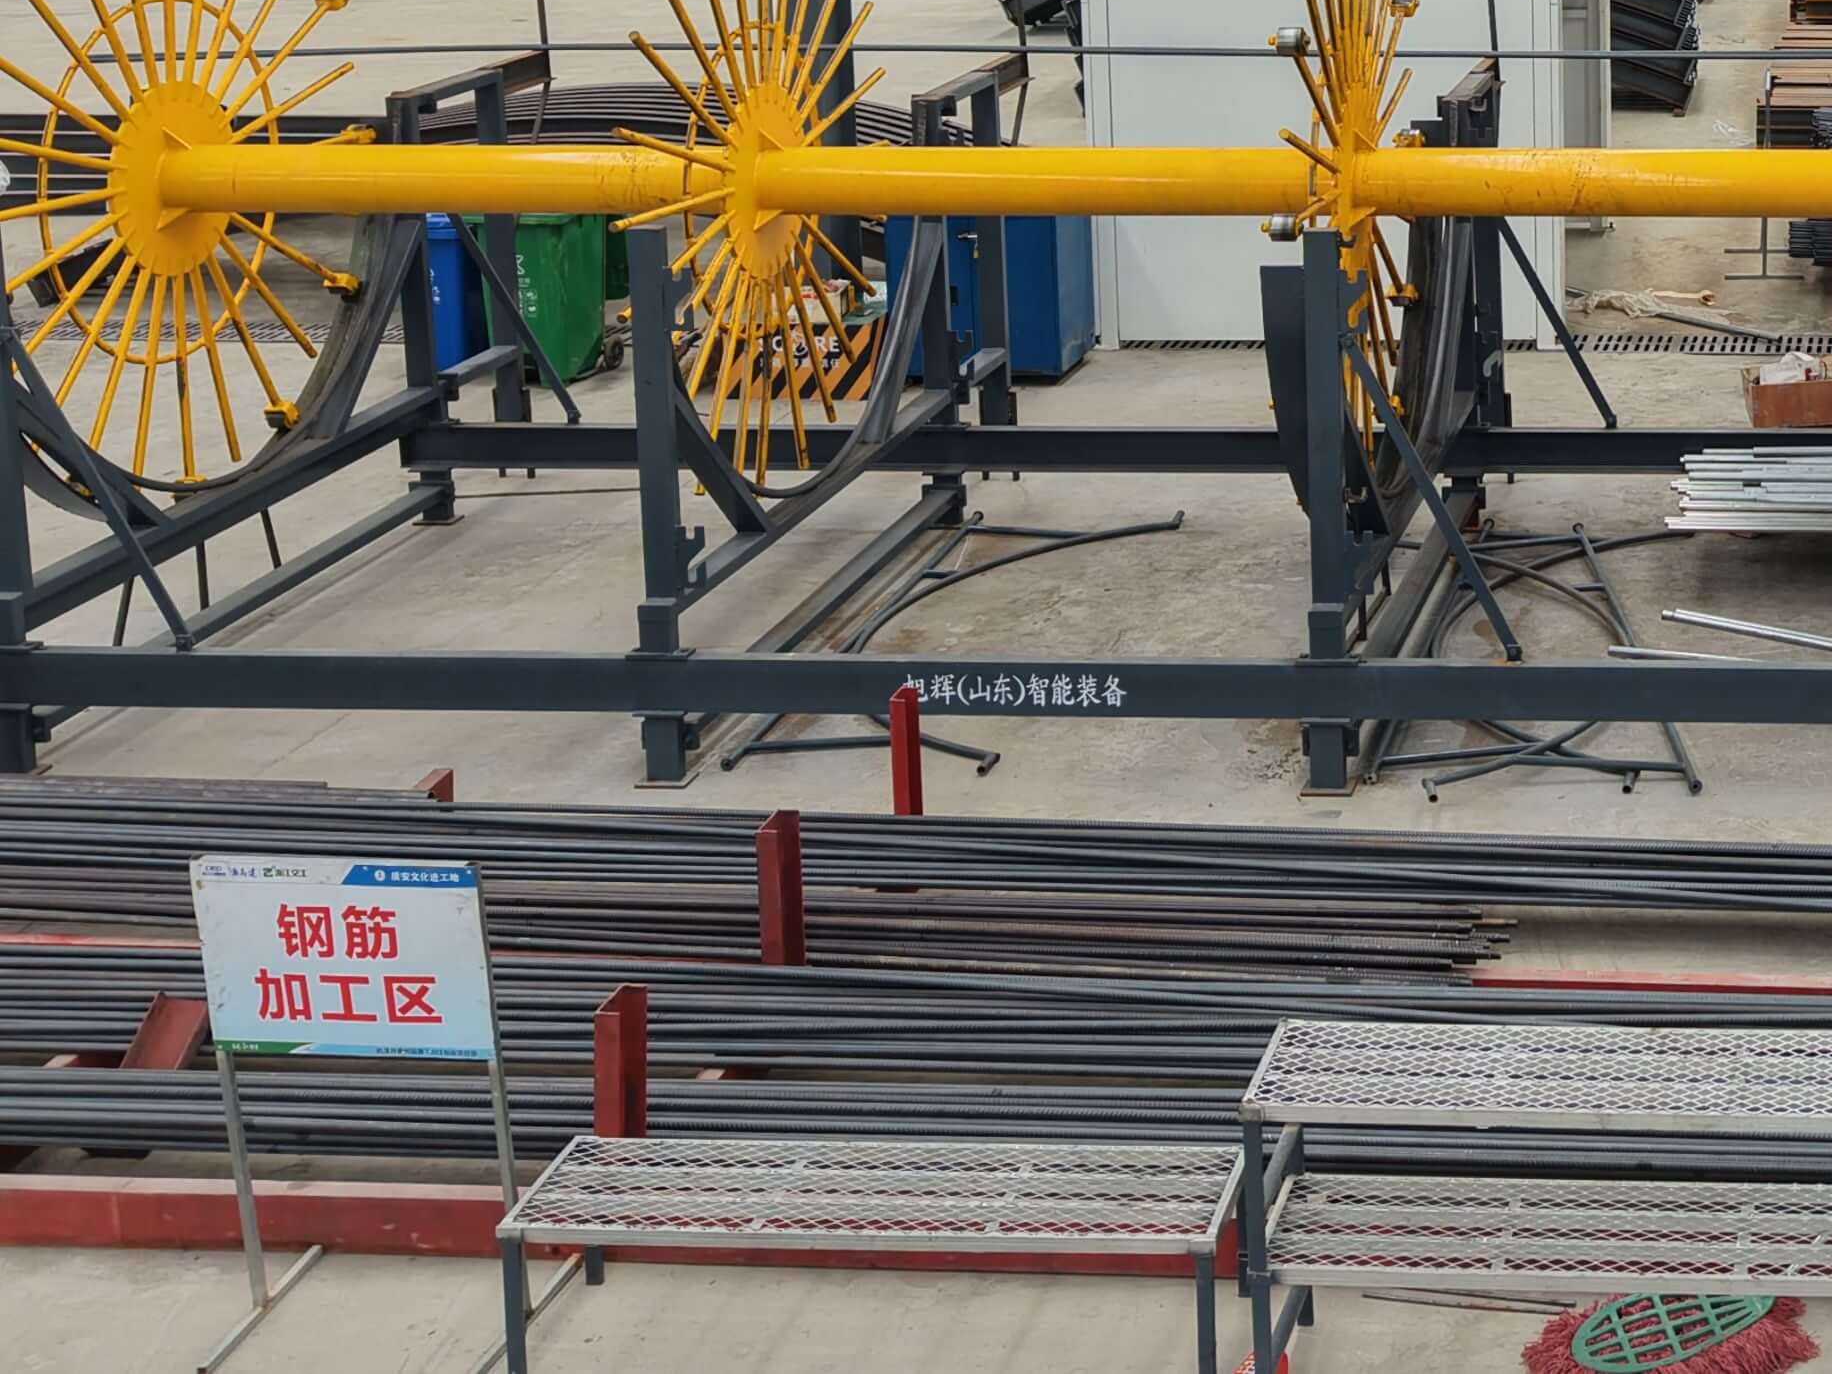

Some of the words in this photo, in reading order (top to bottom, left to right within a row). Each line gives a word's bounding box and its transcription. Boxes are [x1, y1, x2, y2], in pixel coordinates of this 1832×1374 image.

[276, 903, 399, 960] 钢筋
[254, 968, 443, 1024] 加工区
